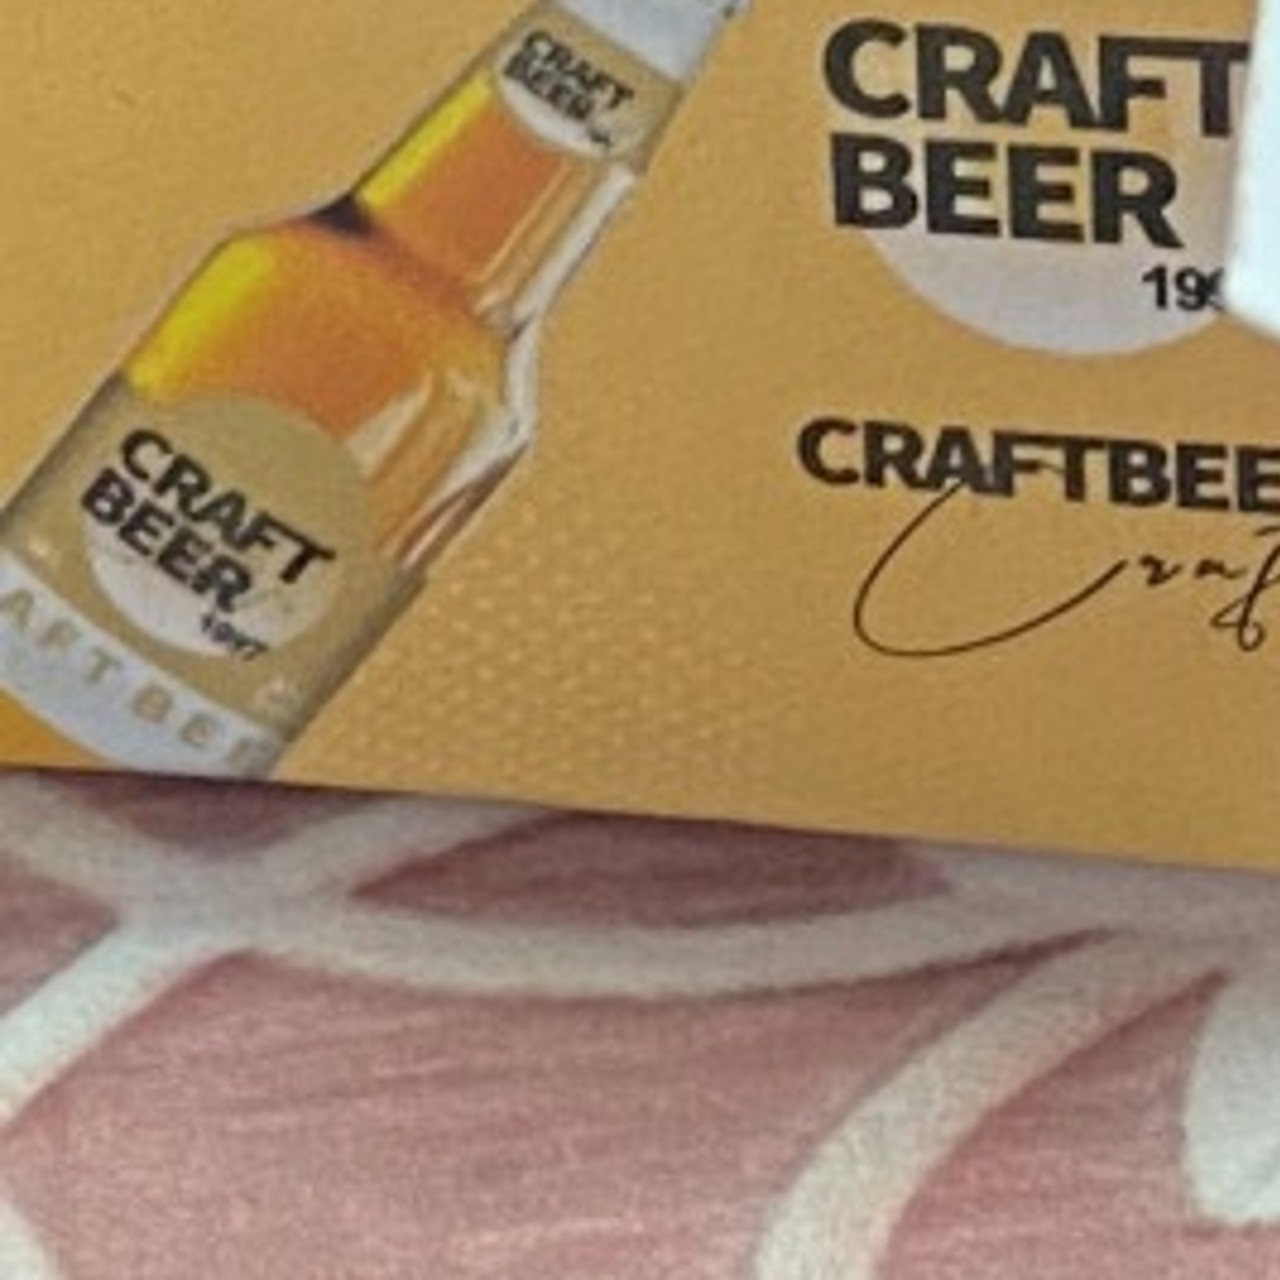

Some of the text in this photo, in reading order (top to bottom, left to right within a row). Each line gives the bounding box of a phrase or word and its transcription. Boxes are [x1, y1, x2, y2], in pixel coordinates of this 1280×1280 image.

[523, 28, 634, 110] CRAFT
[822, 18, 1252, 138] CRAFT
[829, 132, 1184, 248] BEER
[80, 468, 252, 612] BEER
[119, 428, 336, 584] CRAFT
